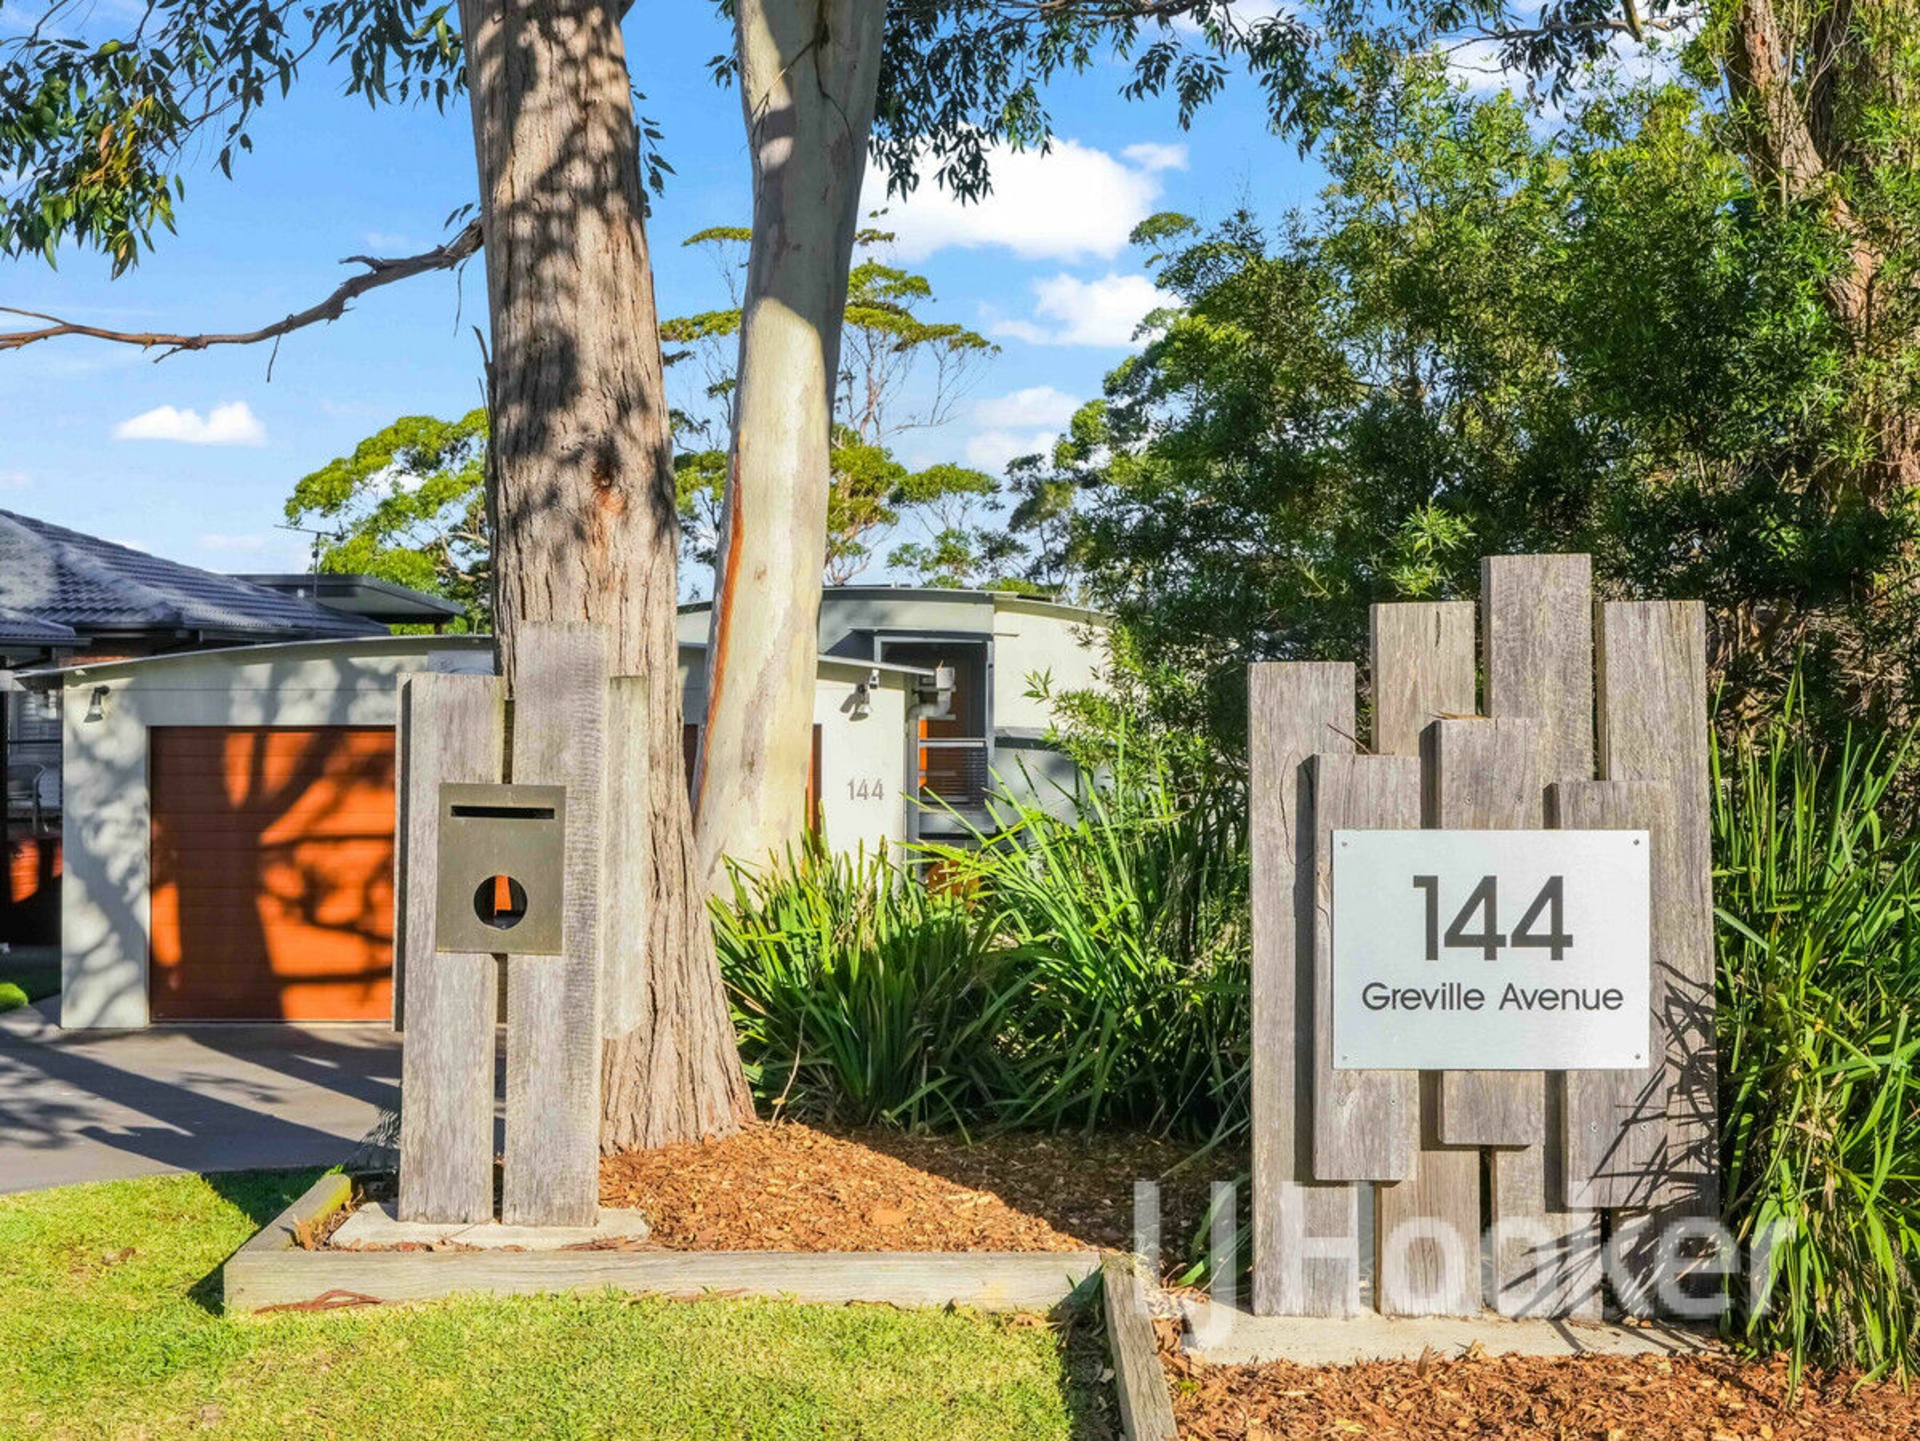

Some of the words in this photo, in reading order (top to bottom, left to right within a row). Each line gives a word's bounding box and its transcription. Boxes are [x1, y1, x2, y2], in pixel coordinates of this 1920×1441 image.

[847, 778, 884, 801] 144
[1413, 875, 1573, 961] 144
[1362, 982, 1485, 1011] Greville
[1499, 983, 1624, 1011] Avenue
